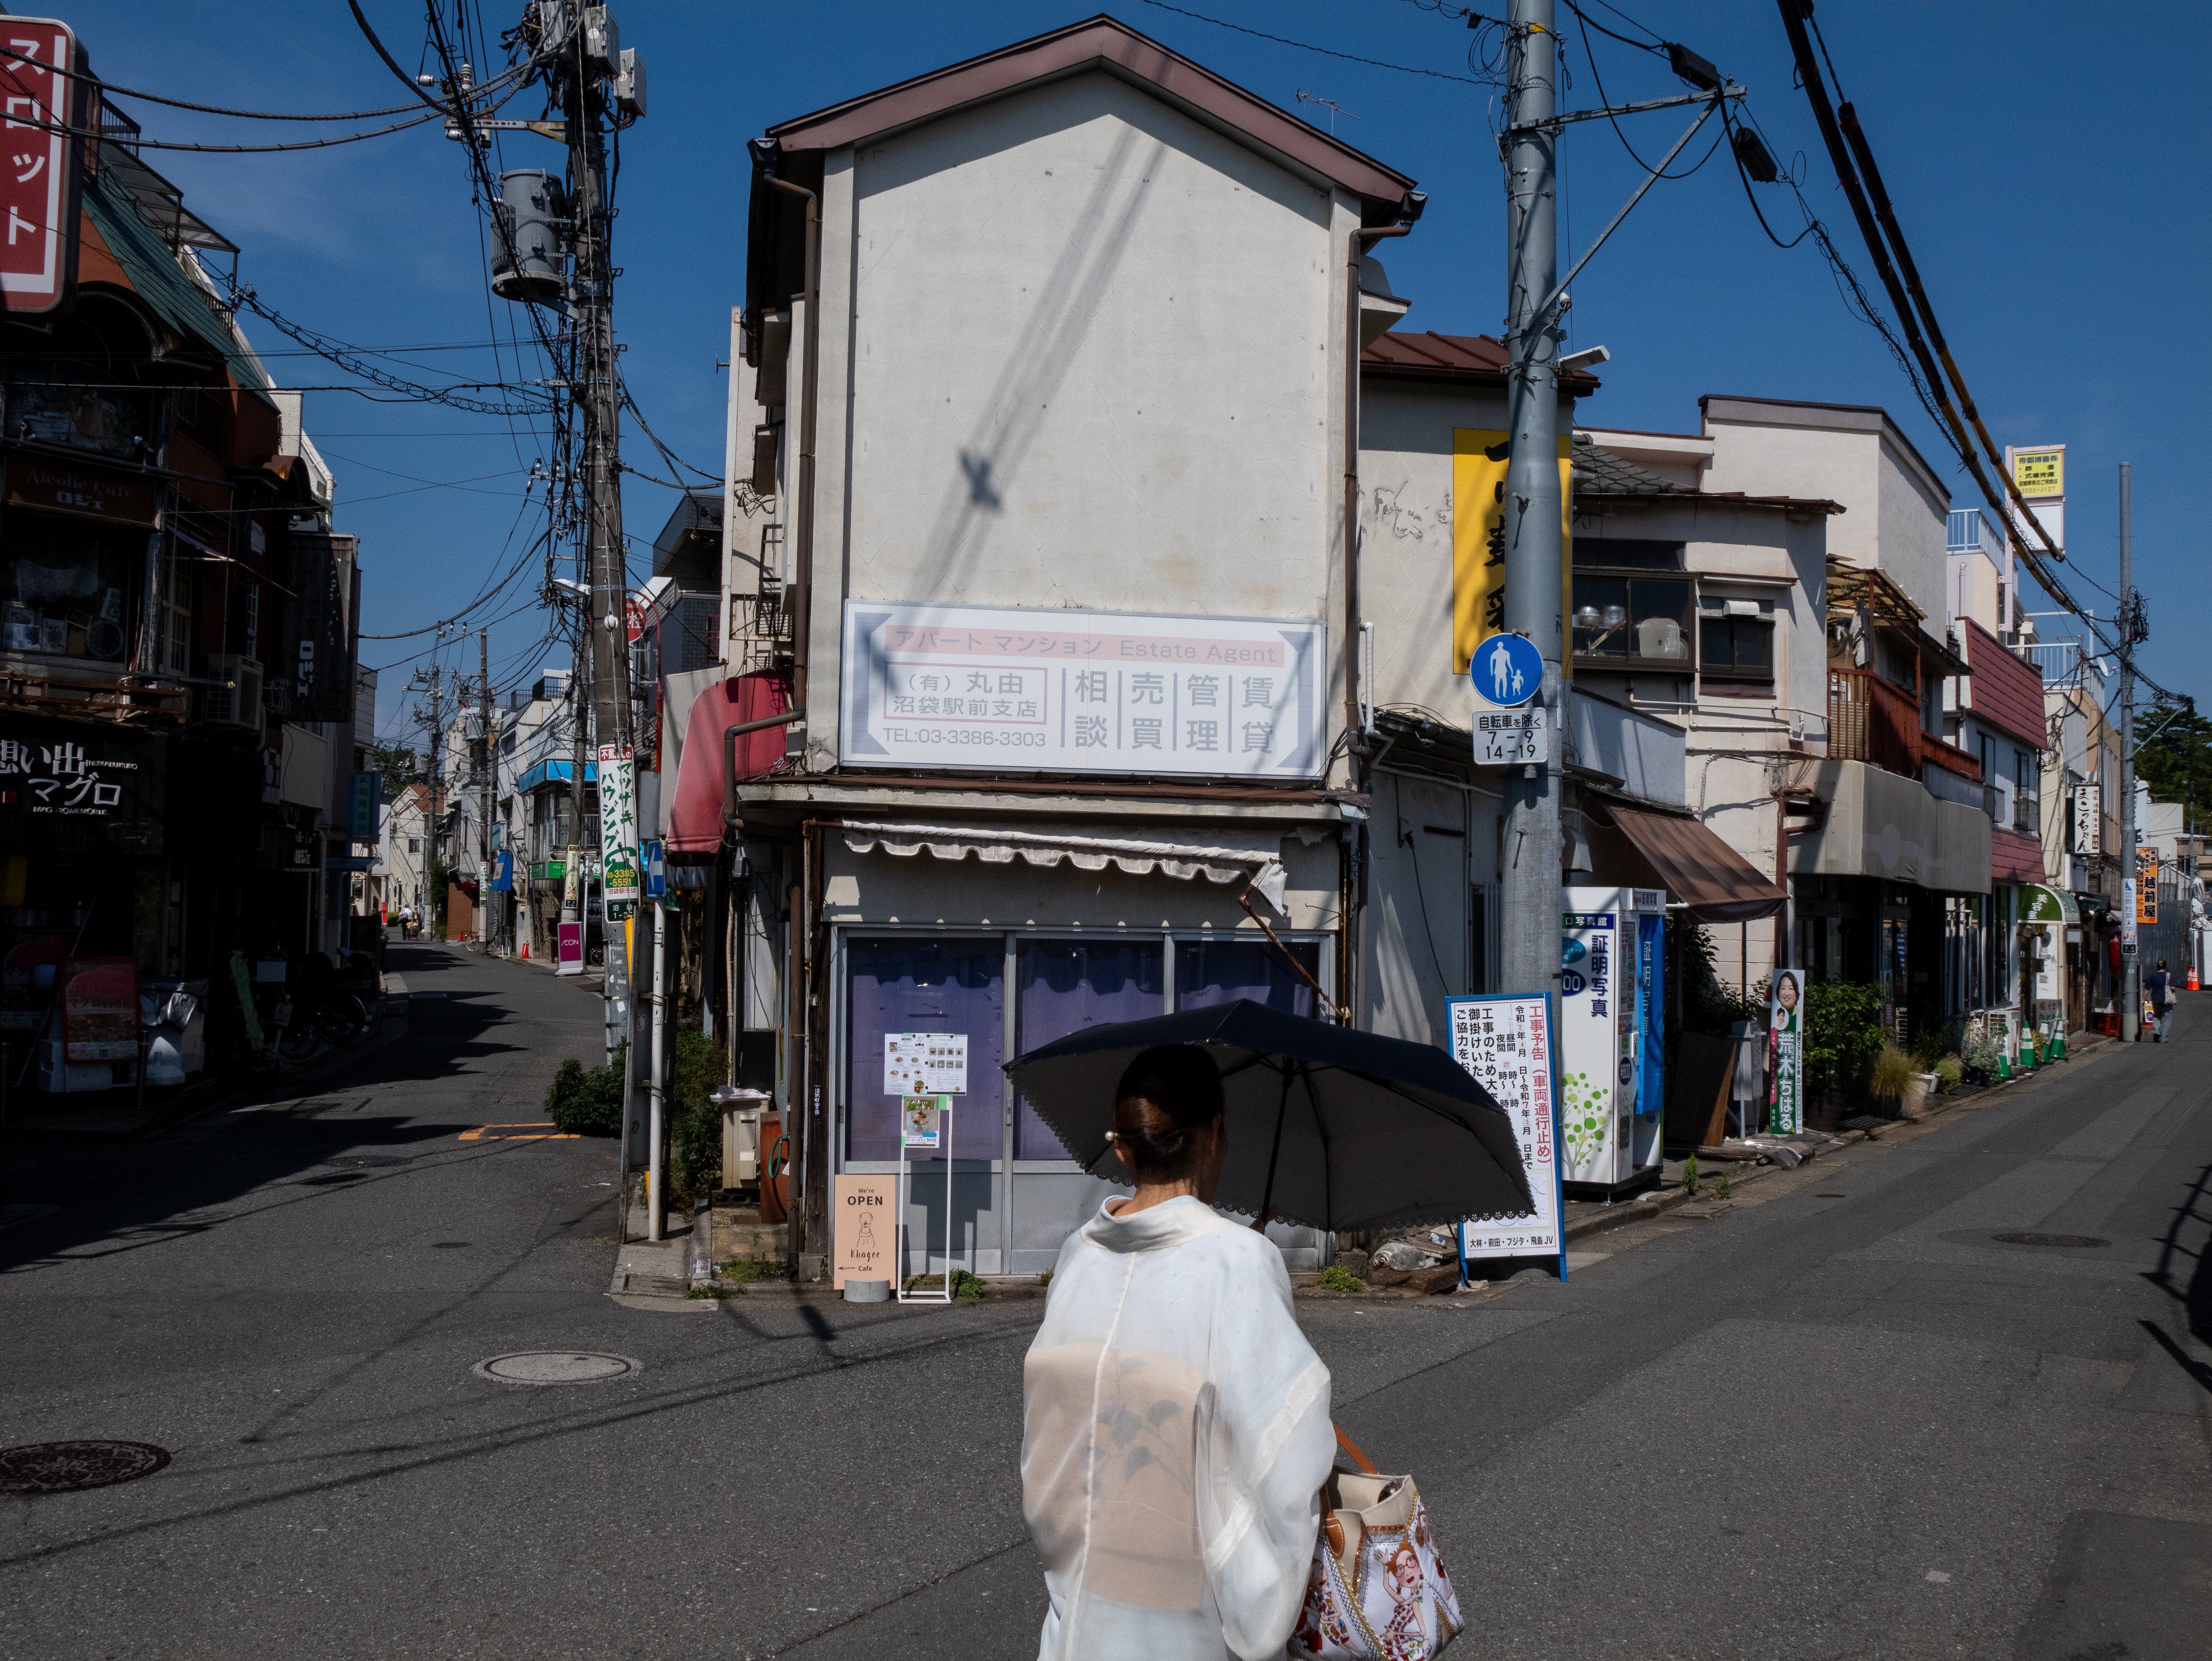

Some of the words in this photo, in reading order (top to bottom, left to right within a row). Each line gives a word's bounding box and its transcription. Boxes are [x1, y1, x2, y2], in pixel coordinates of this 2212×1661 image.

[5, 39, 45, 245] スロット
[57, 491, 104, 509] ロジェ
[896, 631, 982, 651] アパート
[994, 636, 1102, 655] マンション
[1120, 640, 1196, 659] Estate
[1206, 644, 1276, 663] Agent
[298, 640, 314, 698] ロジェ
[966, 671, 1023, 695] 丸由
[893, 695, 1038, 718] 沼袋駅前支店
[1075, 669, 1108, 749] 相談
[1131, 672, 1164, 751] 売買
[1186, 674, 1219, 752] 管理
[1241, 676, 1274, 754] 賃貸
[1479, 714, 1541, 728] 自転車を除く
[882, 727, 1046, 747] TEL:03-3386-3303
[28, 772, 121, 806] マグロ
[617, 762, 634, 827] マツザキ
[602, 773, 620, 850] ハウジング
[2077, 788, 2090, 852] まこっちゃん
[607, 869, 635, 878] 03-3385
[2027, 894, 2048, 919] 美容室
[1562, 916, 1608, 927] ロ写真館
[1563, 975, 1580, 991] 00
[1591, 935, 1608, 1018] 証明写真
[2039, 1001, 2057, 1010] 着付
[1468, 1008, 1484, 1087] 御掛けいた
[1496, 1034, 1506, 1053] 夜間
[1506, 1034, 1516, 1052] 昼間
[1777, 1032, 1795, 1131] 荒木ちはる
[847, 1196, 883, 1206] OPEN
[1544, 1236, 1553, 1245] JV
[851, 1249, 880, 1262] Khagee
